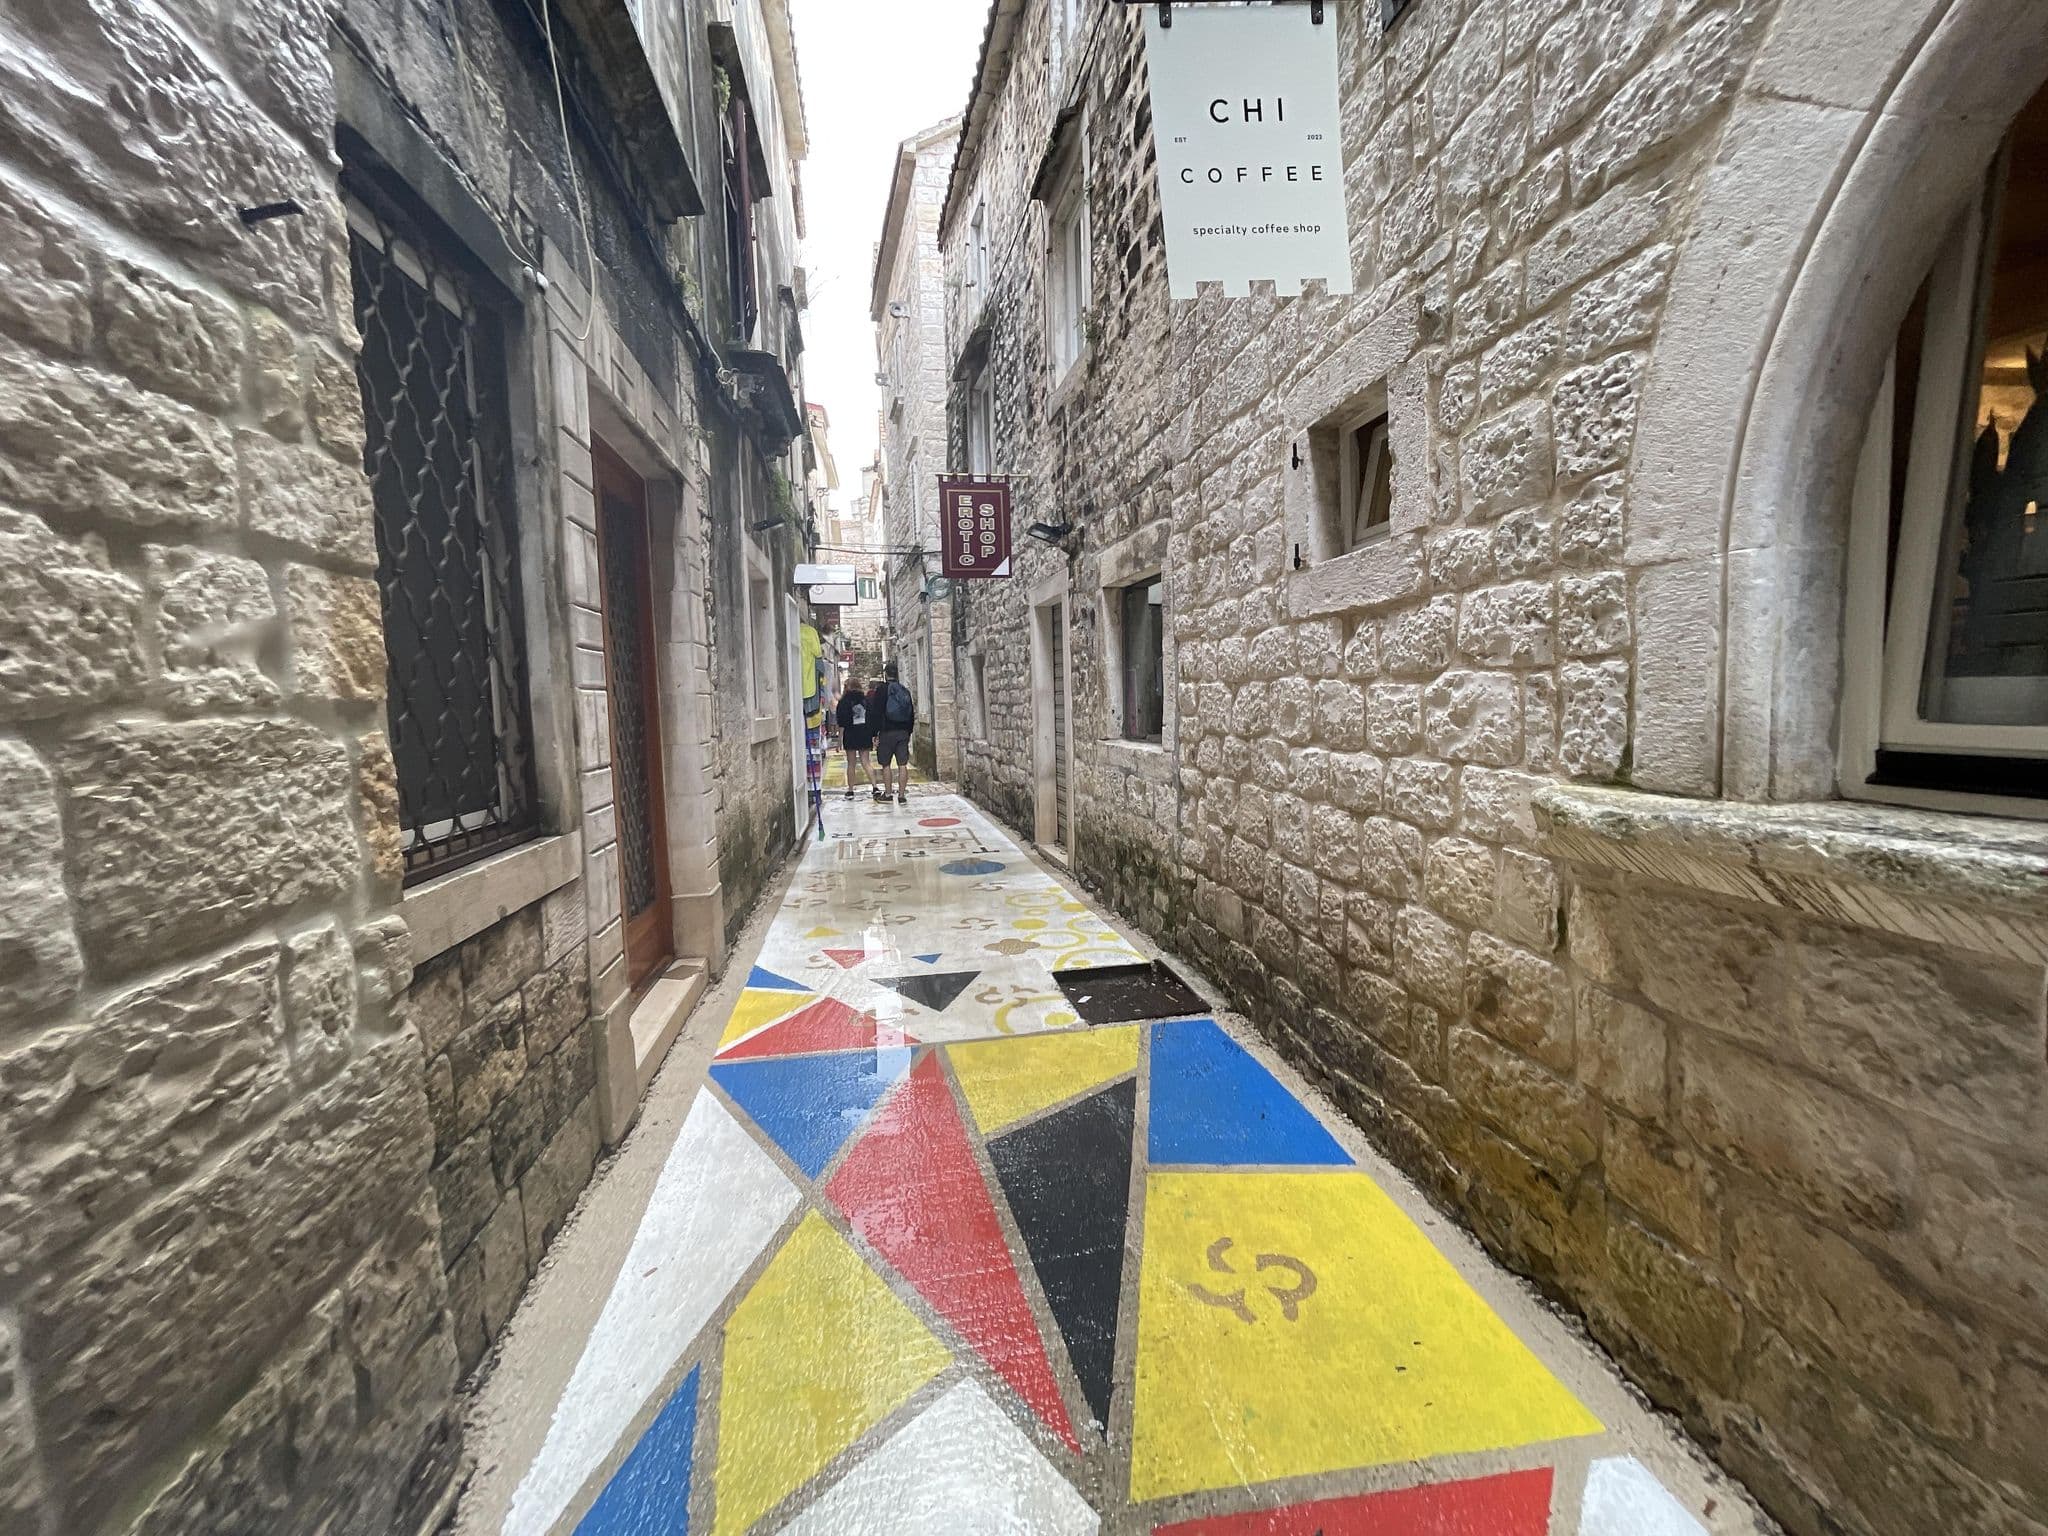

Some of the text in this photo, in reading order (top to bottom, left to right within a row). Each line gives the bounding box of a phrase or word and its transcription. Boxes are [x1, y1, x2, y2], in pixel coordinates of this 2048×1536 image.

[1209, 97, 1284, 124] CHI
[1180, 165, 1323, 184] COFFEE
[1192, 223, 1321, 237] specialty coffee shop
[957, 494, 975, 566] EROTIC
[979, 503, 996, 558] SHOP
